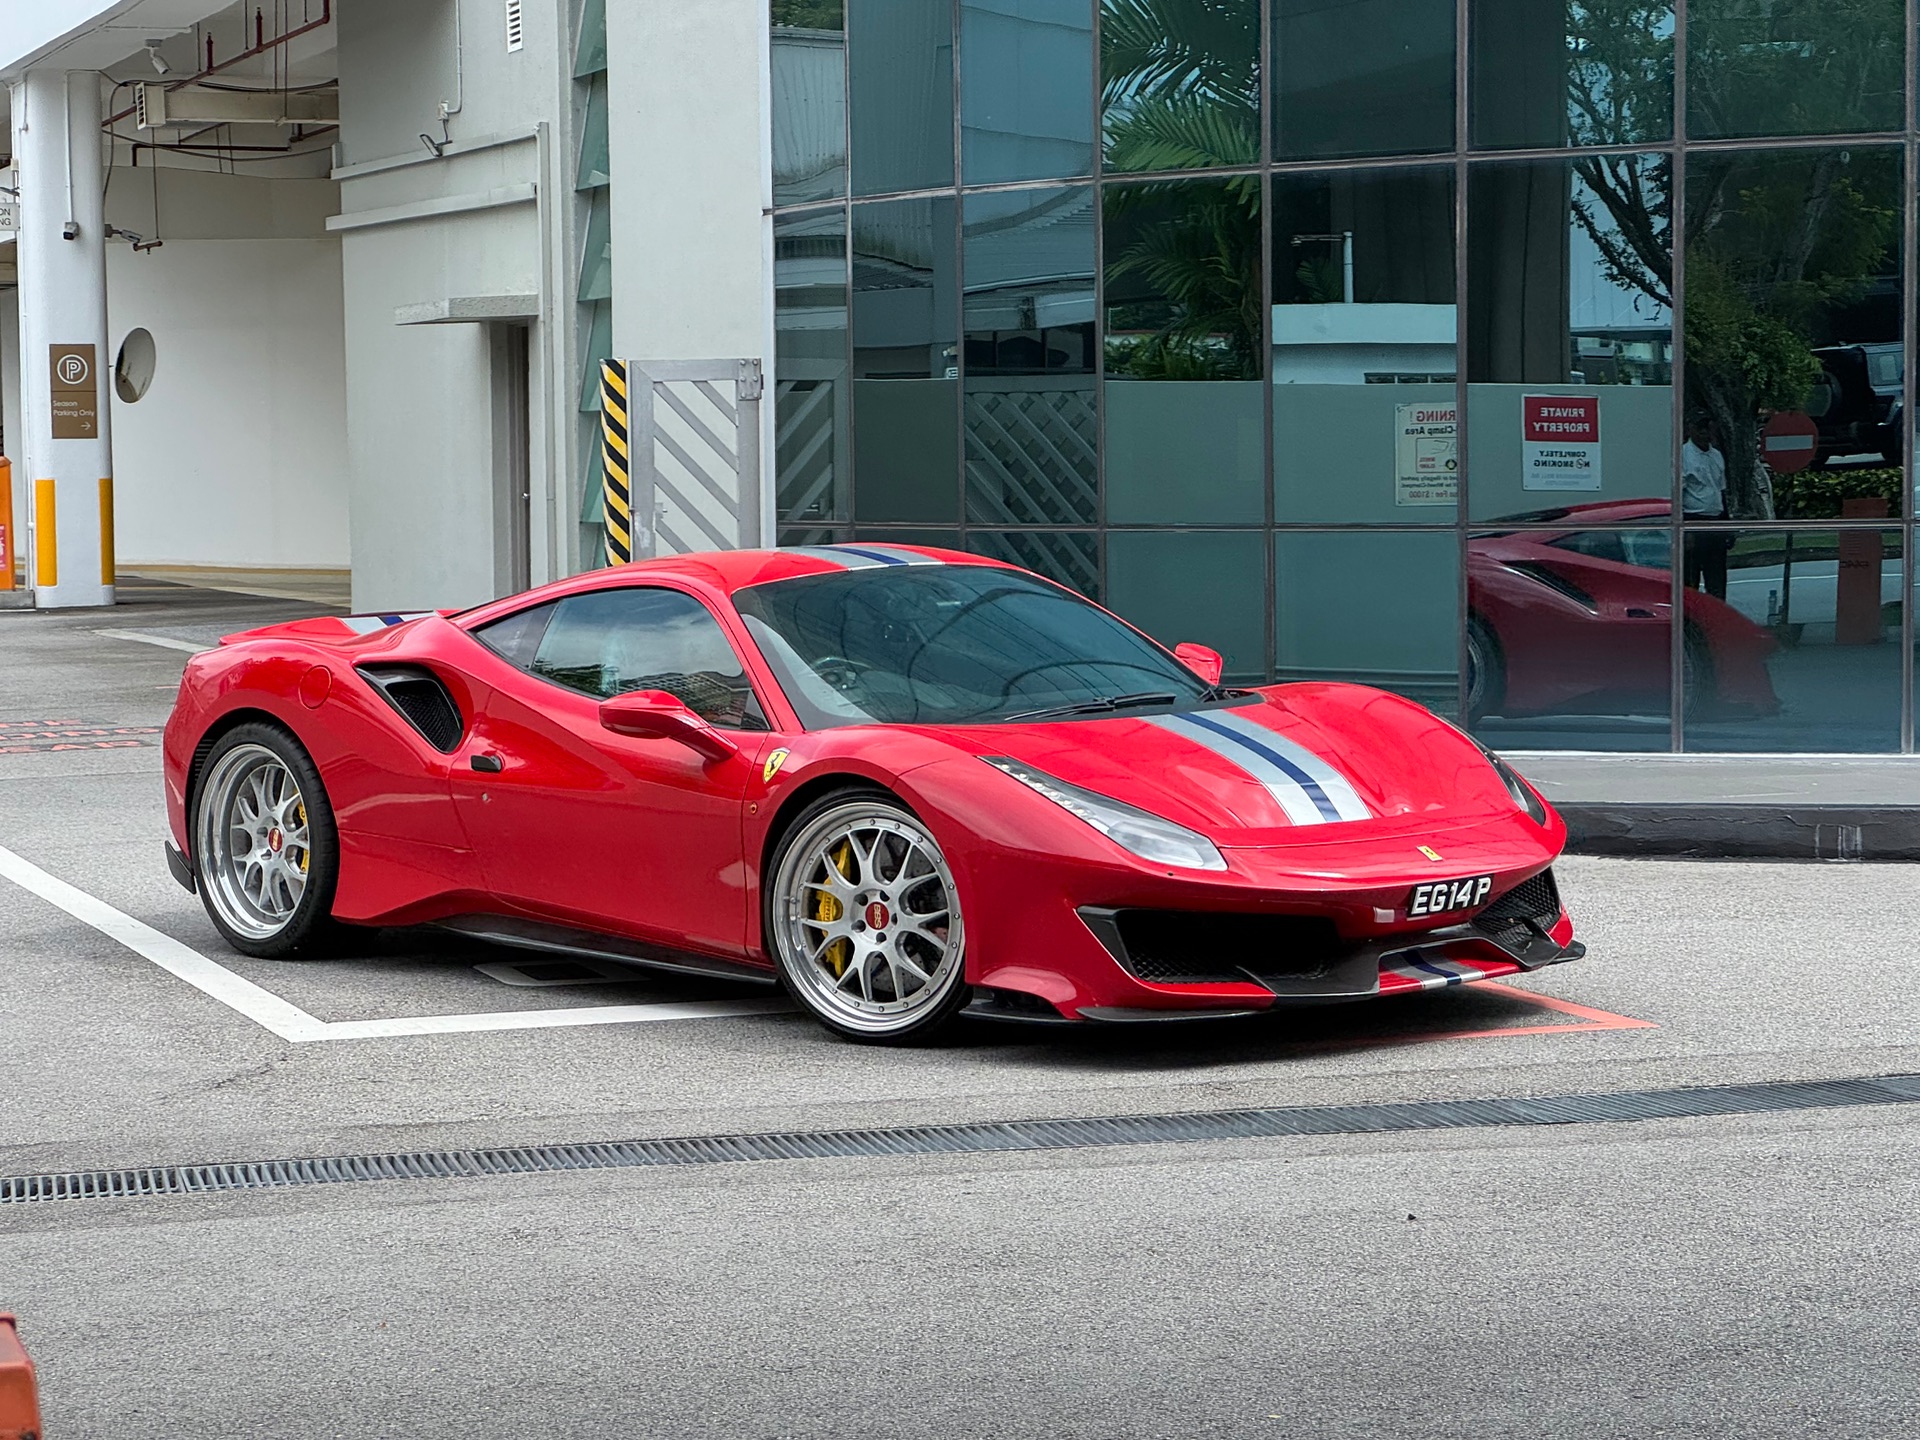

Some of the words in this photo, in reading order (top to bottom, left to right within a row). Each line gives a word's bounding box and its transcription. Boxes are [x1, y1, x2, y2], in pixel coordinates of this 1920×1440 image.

[1187, 203, 1229, 226] EXIT
[53, 409, 78, 418] Parking
[79, 409, 95, 417] Only
